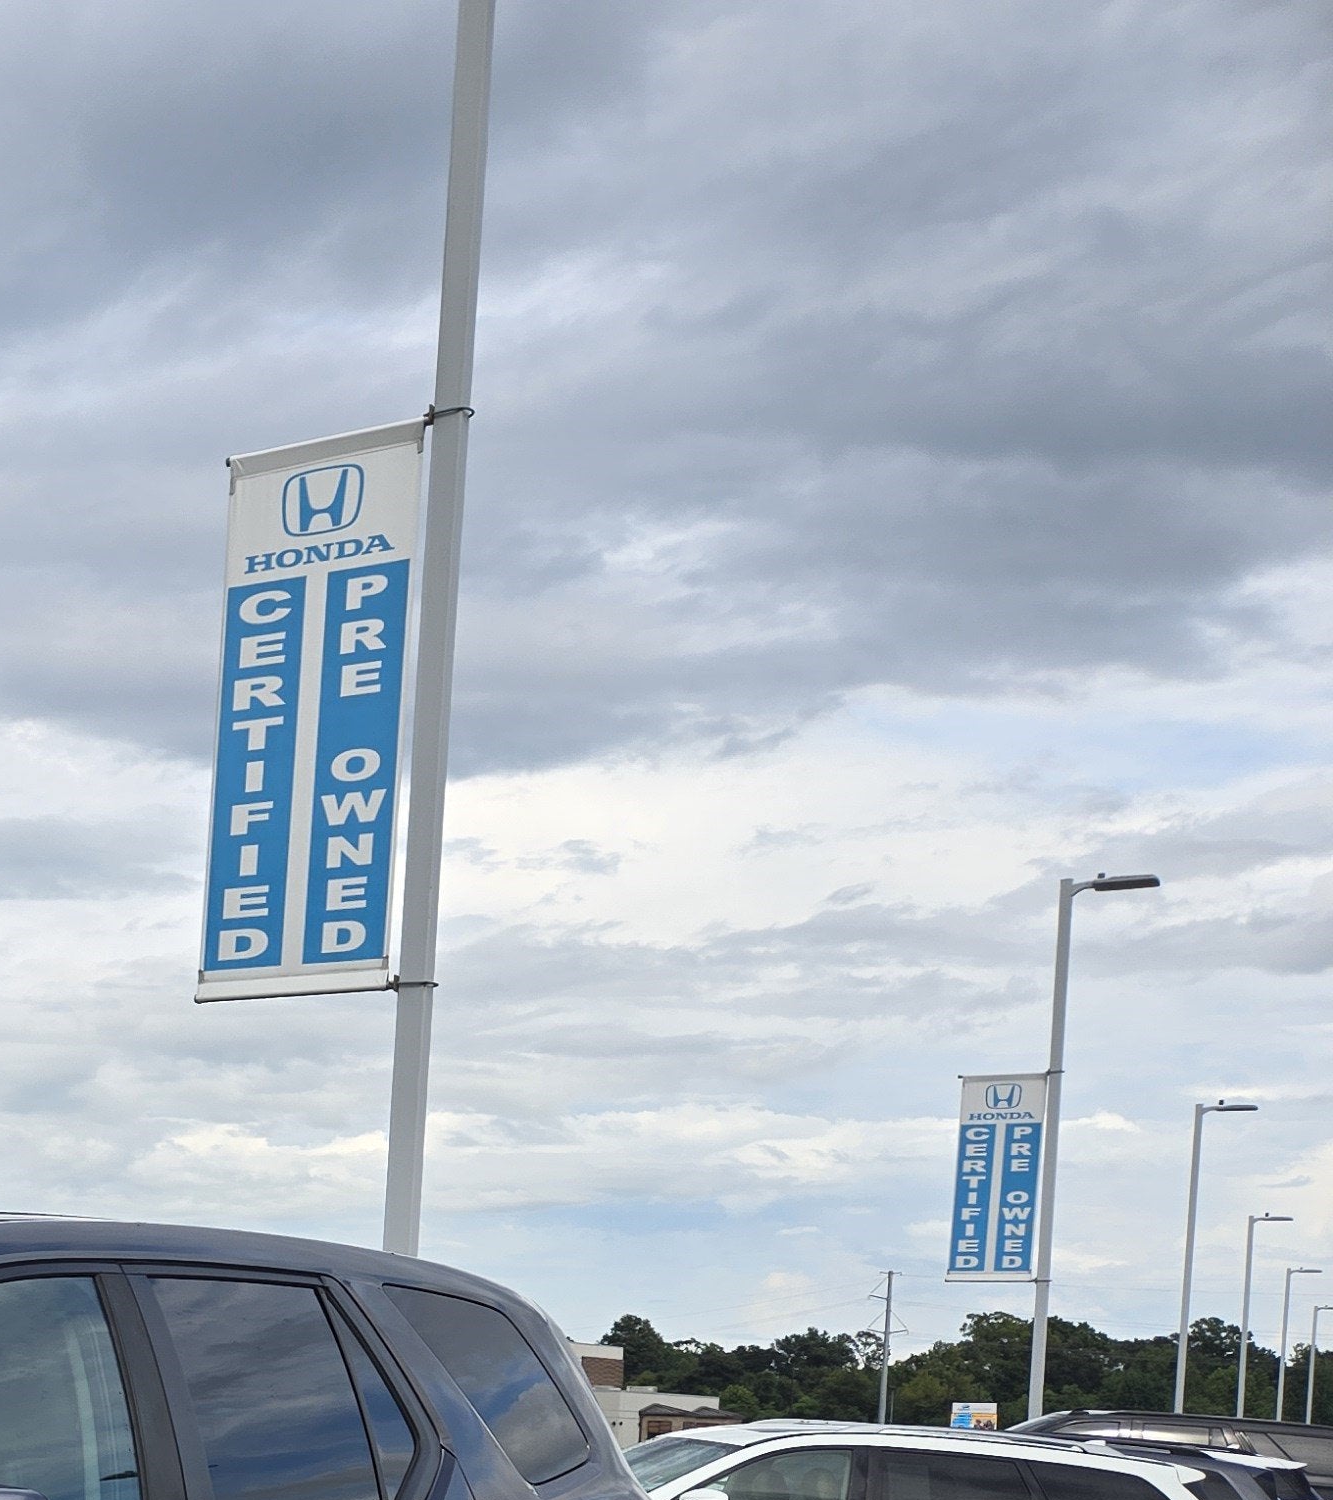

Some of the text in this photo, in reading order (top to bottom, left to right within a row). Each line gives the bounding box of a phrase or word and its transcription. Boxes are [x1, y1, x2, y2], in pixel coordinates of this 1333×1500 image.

[243, 533, 395, 574] HONDA
[216, 589, 293, 962] CERTIFIED
[320, 573, 389, 954] PRE OWNED
[968, 1111, 1035, 1121] HONDA
[954, 1126, 990, 1269] CERTIFIED
[1001, 1126, 1033, 1269] PRE OWNED
